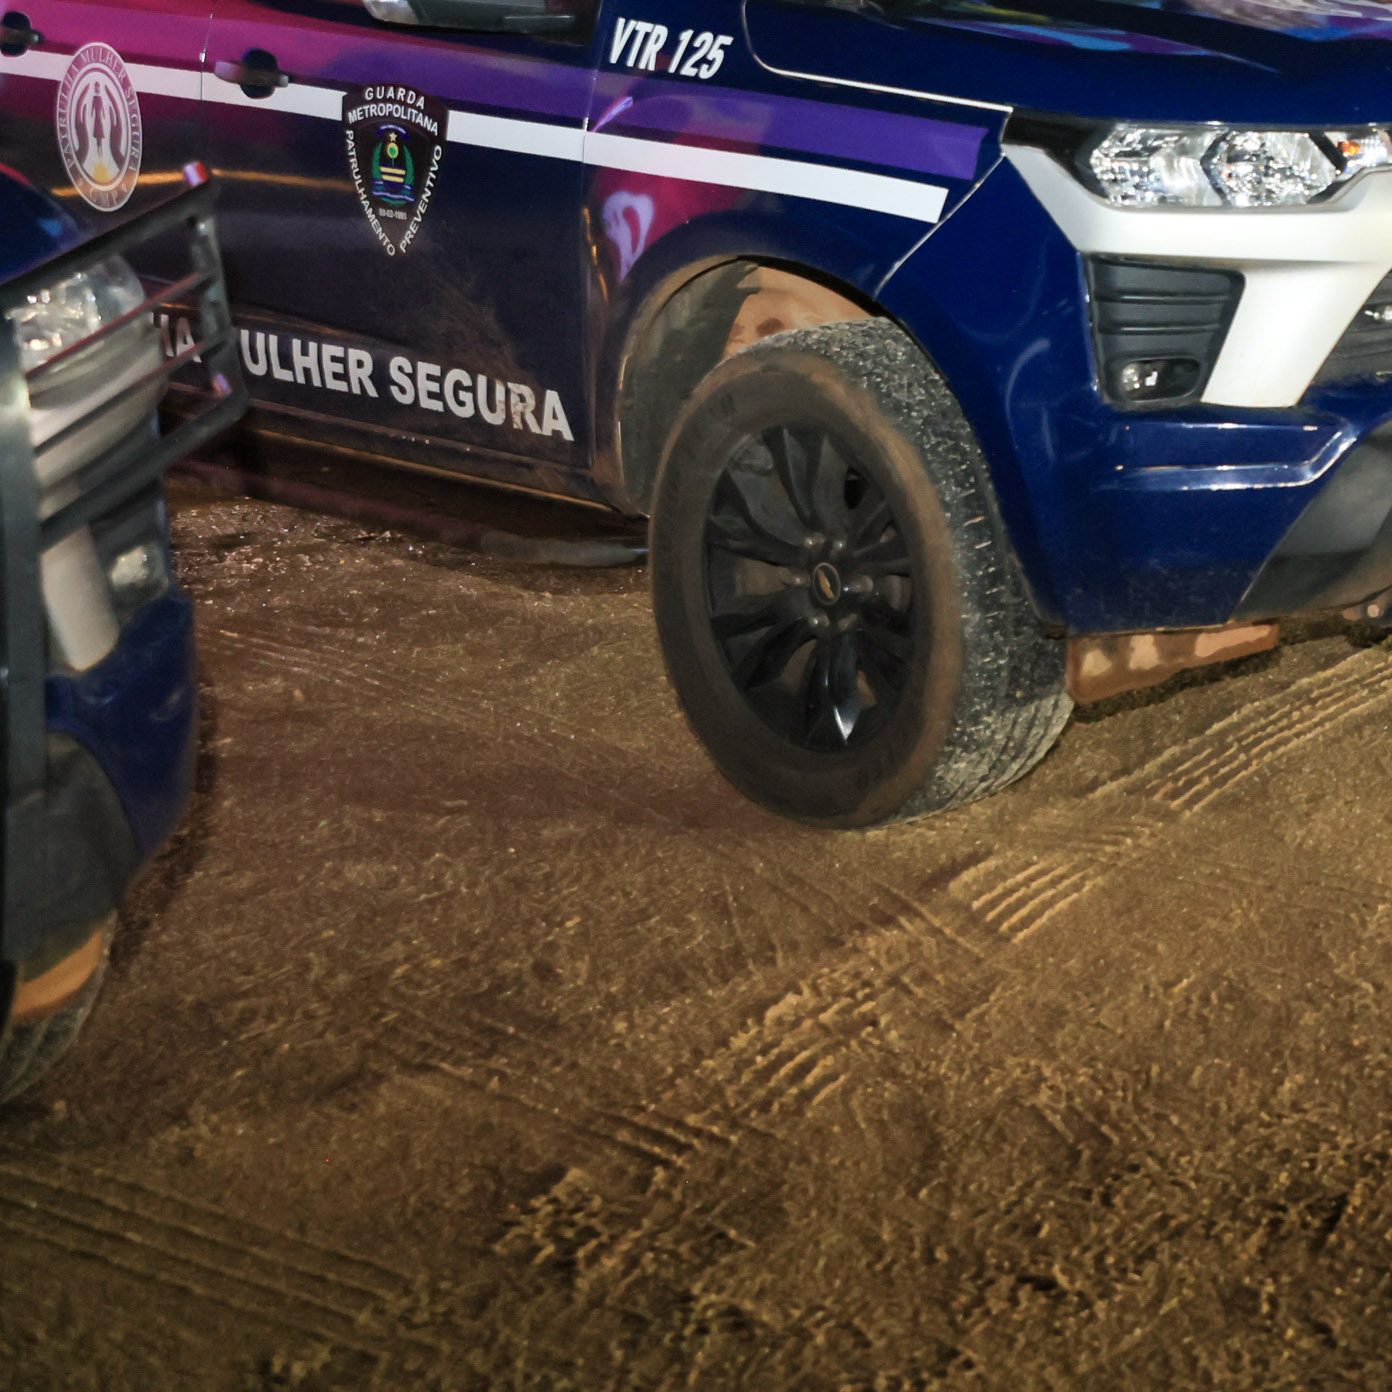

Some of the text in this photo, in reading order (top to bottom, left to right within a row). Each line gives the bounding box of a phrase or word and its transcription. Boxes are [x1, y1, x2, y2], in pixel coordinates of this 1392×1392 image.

[80, 47, 127, 84] MULHER
[609, 17, 734, 79] VTR 125
[348, 103, 439, 137] METROPOLITANA
[364, 86, 426, 110] GUARDA
[345, 129, 443, 257] PATRULHAMENTO PREVENTIVO
[239, 328, 379, 399] ULHER
[388, 355, 575, 442] SEGURA
